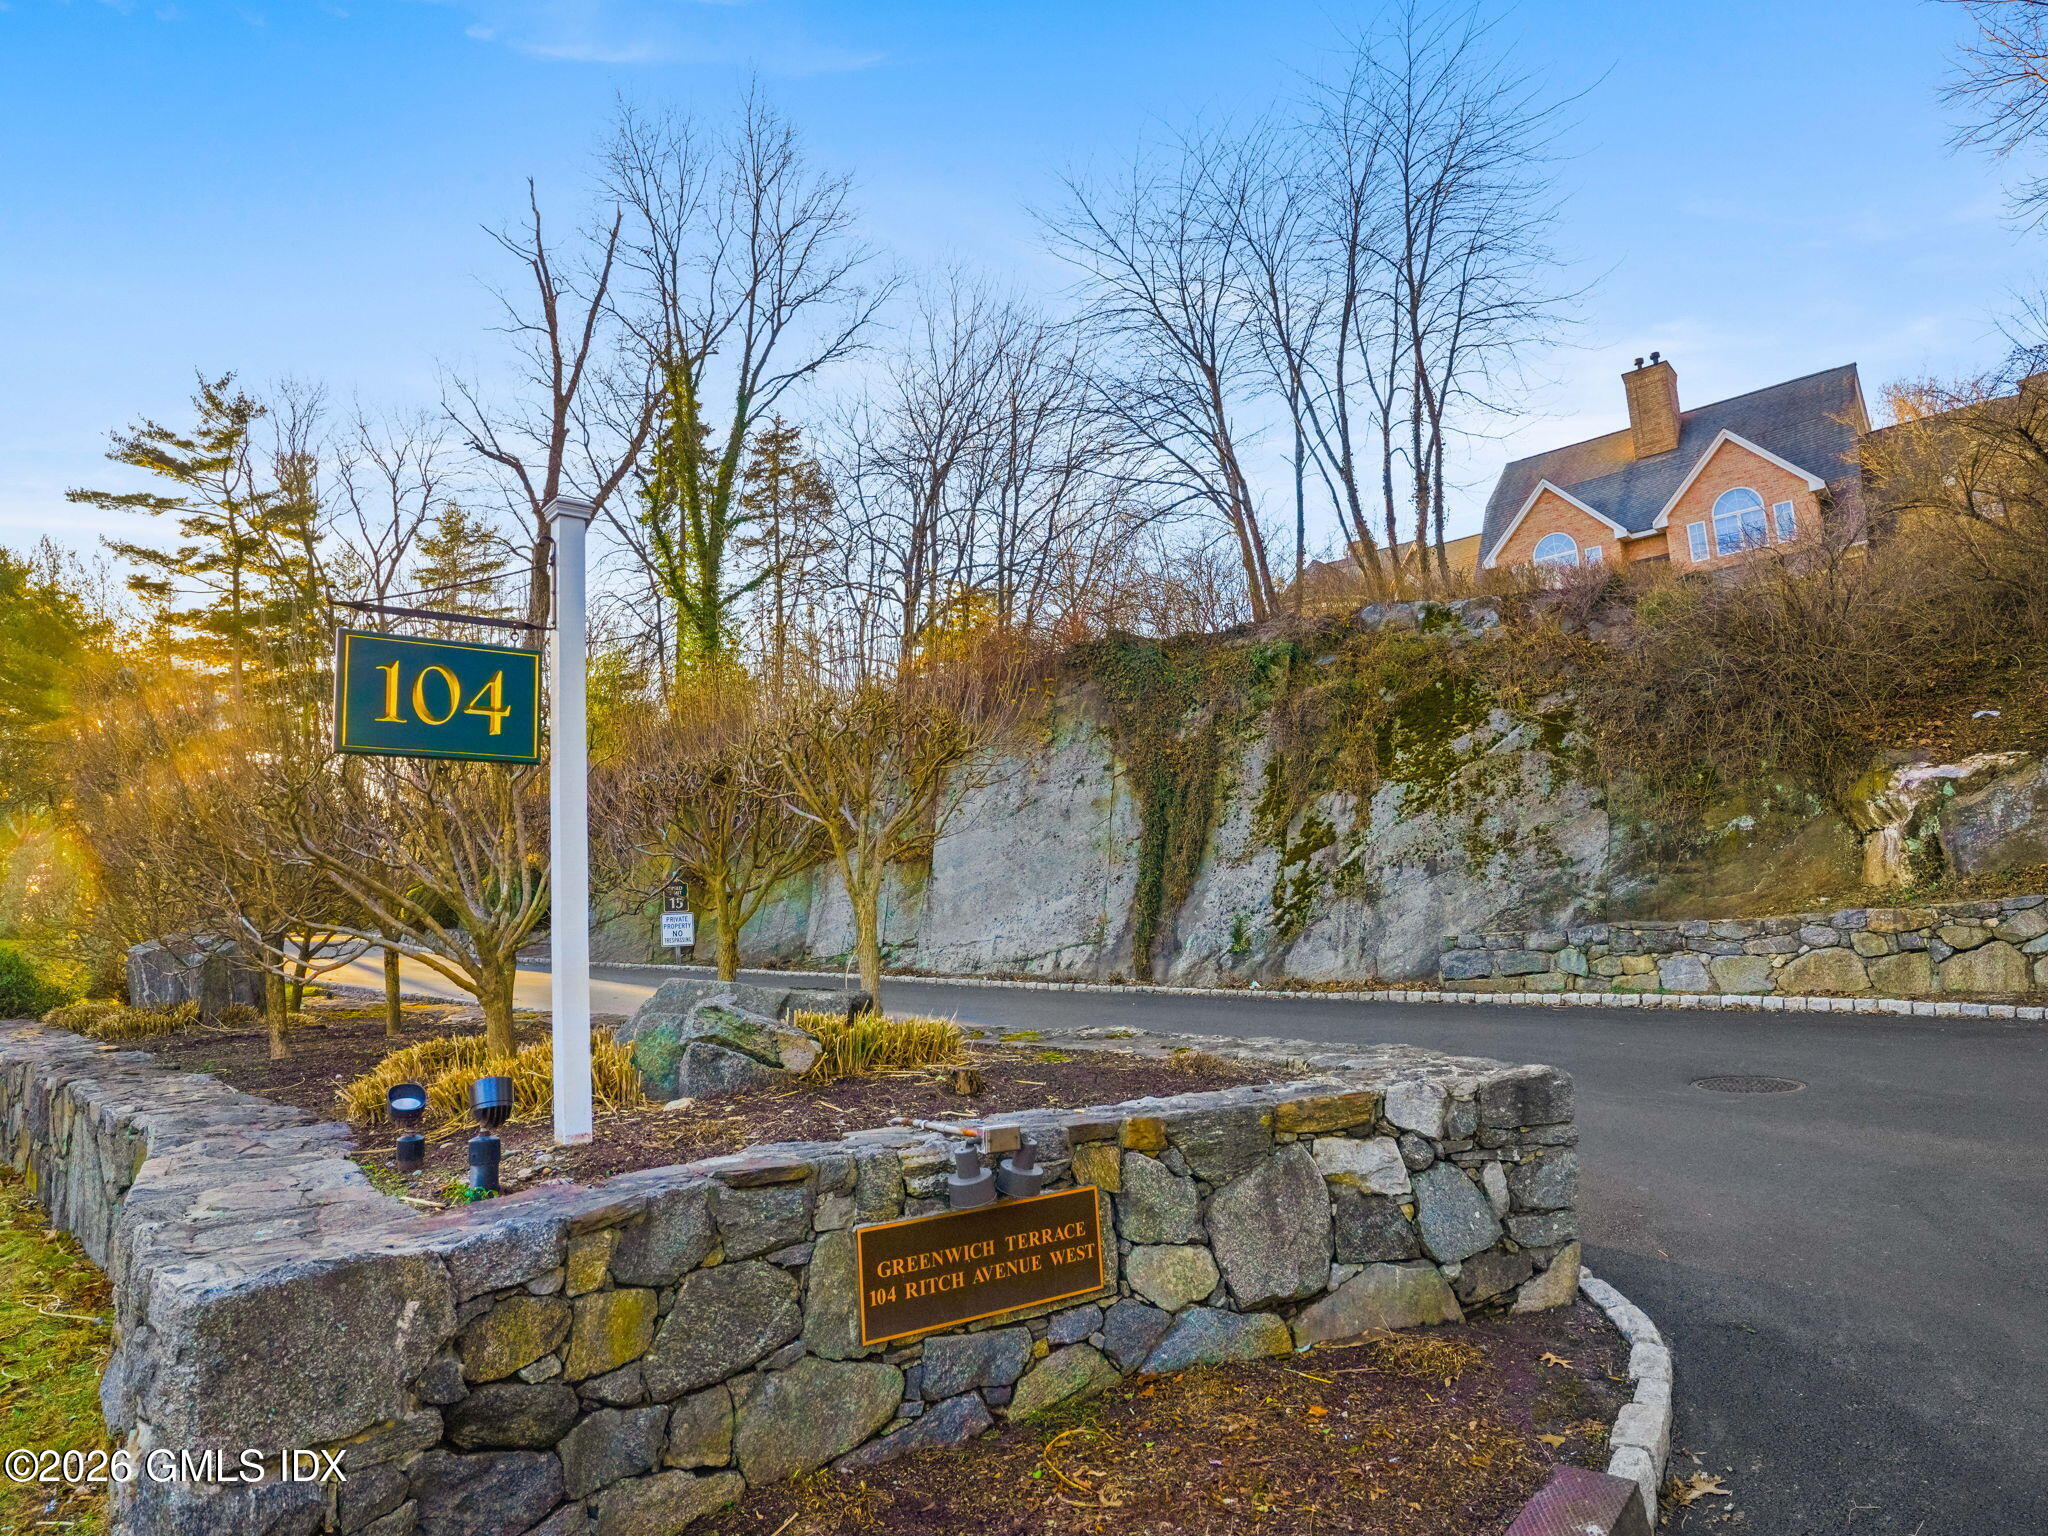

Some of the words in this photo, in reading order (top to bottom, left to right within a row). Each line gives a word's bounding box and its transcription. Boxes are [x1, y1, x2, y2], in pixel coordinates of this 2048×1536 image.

[375, 660, 511, 735] 104
[670, 897, 684, 909] 15
[869, 1286, 897, 1307] 104
[905, 1271, 965, 1300] RITCH
[973, 1255, 1042, 1285] AVENUE
[1049, 1243, 1096, 1267] WEST
[876, 1240, 995, 1278] GREENWICH
[1005, 1221, 1086, 1251] TERRACE
